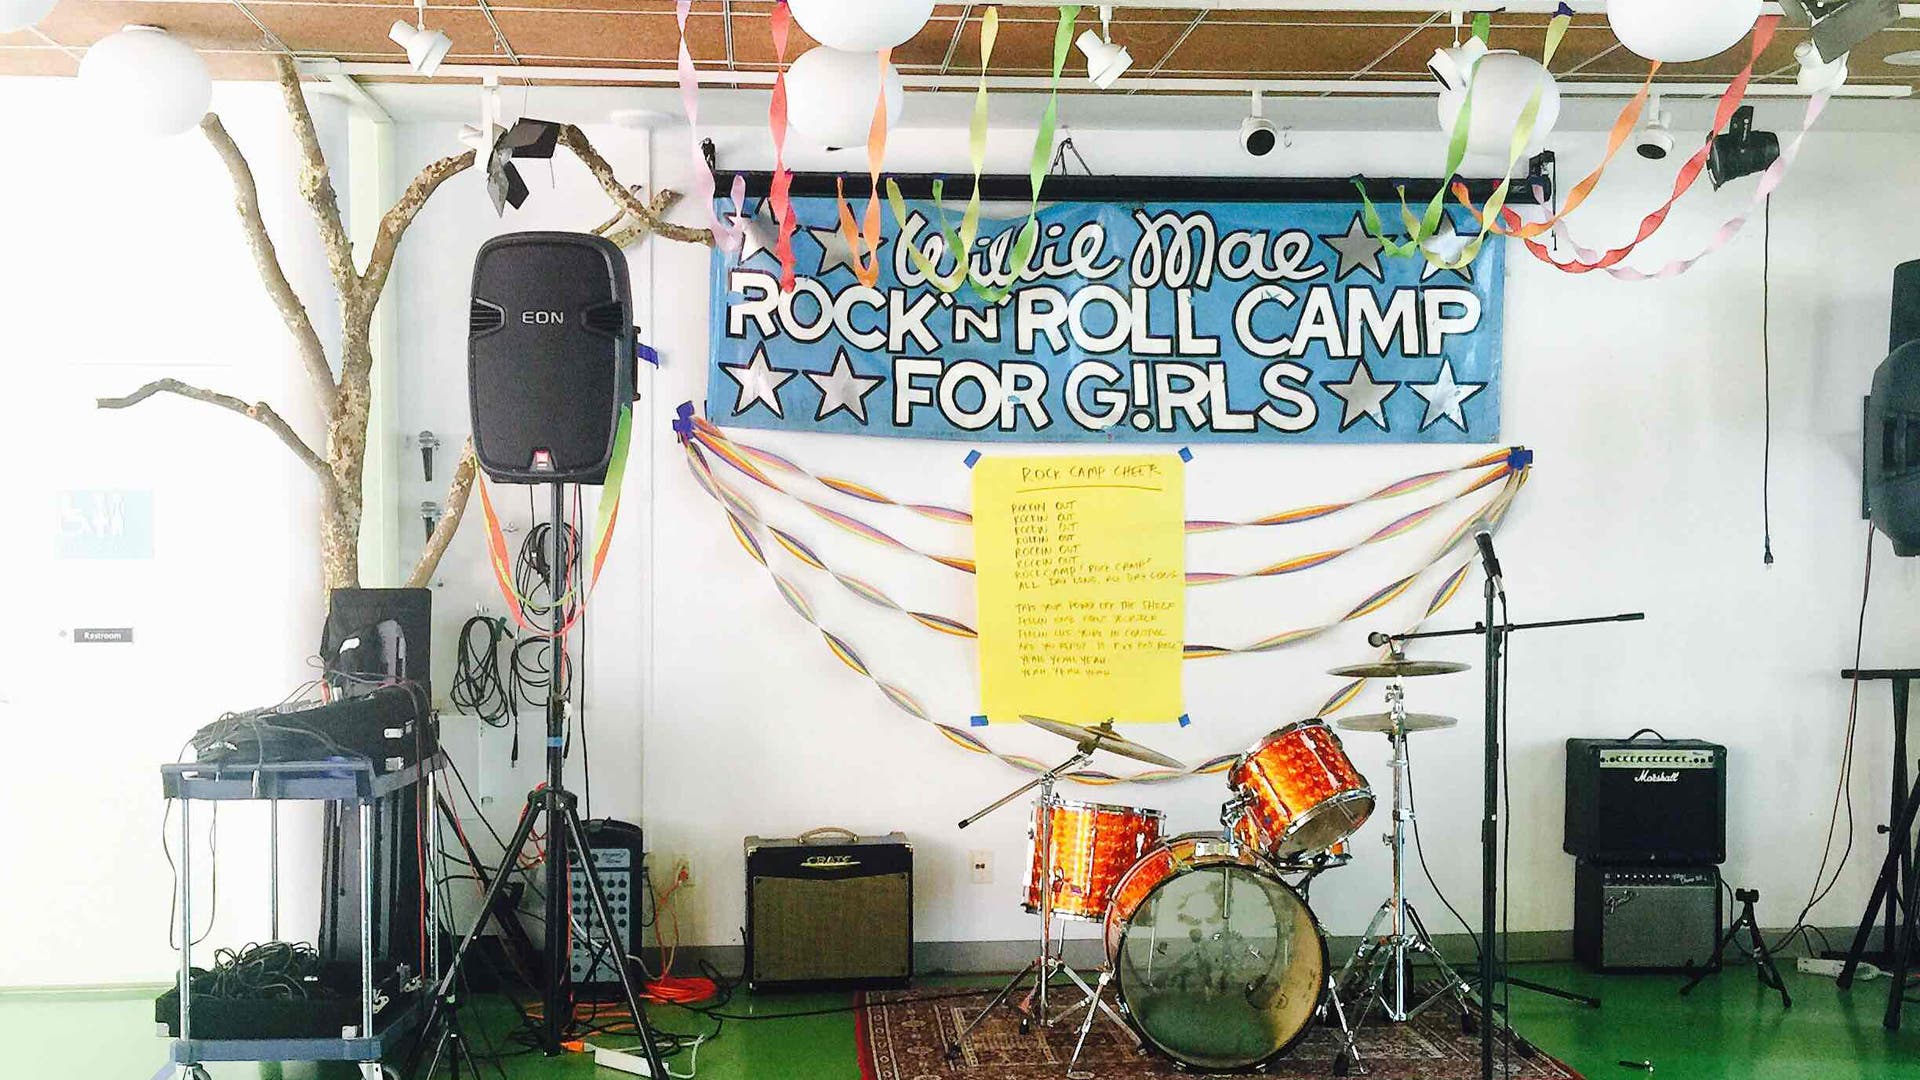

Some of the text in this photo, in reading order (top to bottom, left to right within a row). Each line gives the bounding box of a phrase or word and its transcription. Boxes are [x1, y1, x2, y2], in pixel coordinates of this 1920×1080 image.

[894, 209, 1326, 290] Willie Mae
[522, 311, 564, 324] EON
[1235, 285, 1483, 358] CAMP
[892, 357, 1050, 430] FOR
[1022, 464, 1162, 483] ROCK CAMP CHEER
[83, 631, 122, 640] Restroom
[1634, 769, 1680, 782] Marshall
[806, 855, 852, 865] CRATE
